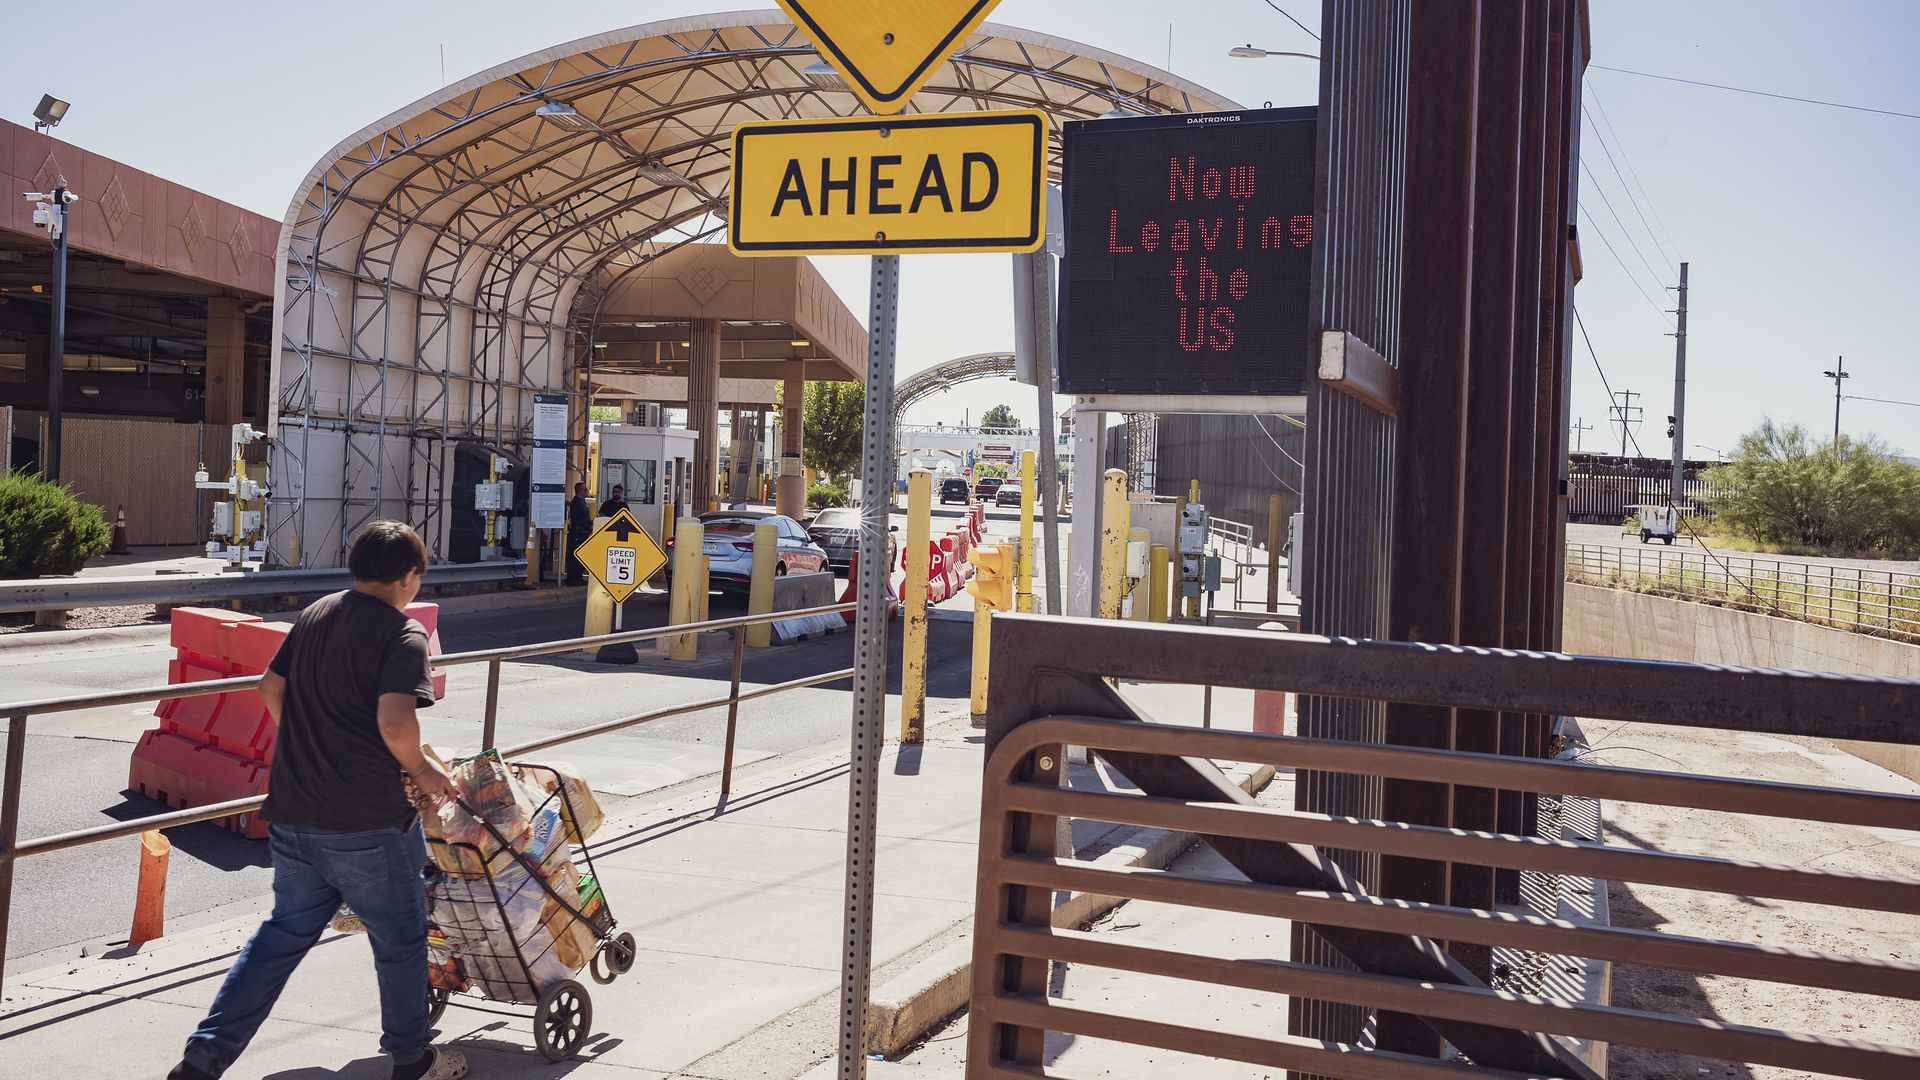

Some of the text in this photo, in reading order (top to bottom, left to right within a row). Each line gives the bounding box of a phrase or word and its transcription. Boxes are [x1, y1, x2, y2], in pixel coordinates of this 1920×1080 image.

[1187, 116, 1241, 124] DAKTRONICS
[770, 151, 999, 217] AHEAD
[1169, 156, 1256, 201] Now
[1109, 204, 1313, 254] Leaving
[1170, 256, 1249, 301] the
[1179, 306, 1235, 352] US
[609, 550, 635, 558] SPEED
[610, 558, 631, 566] LIMIT
[618, 567, 629, 580] 5
